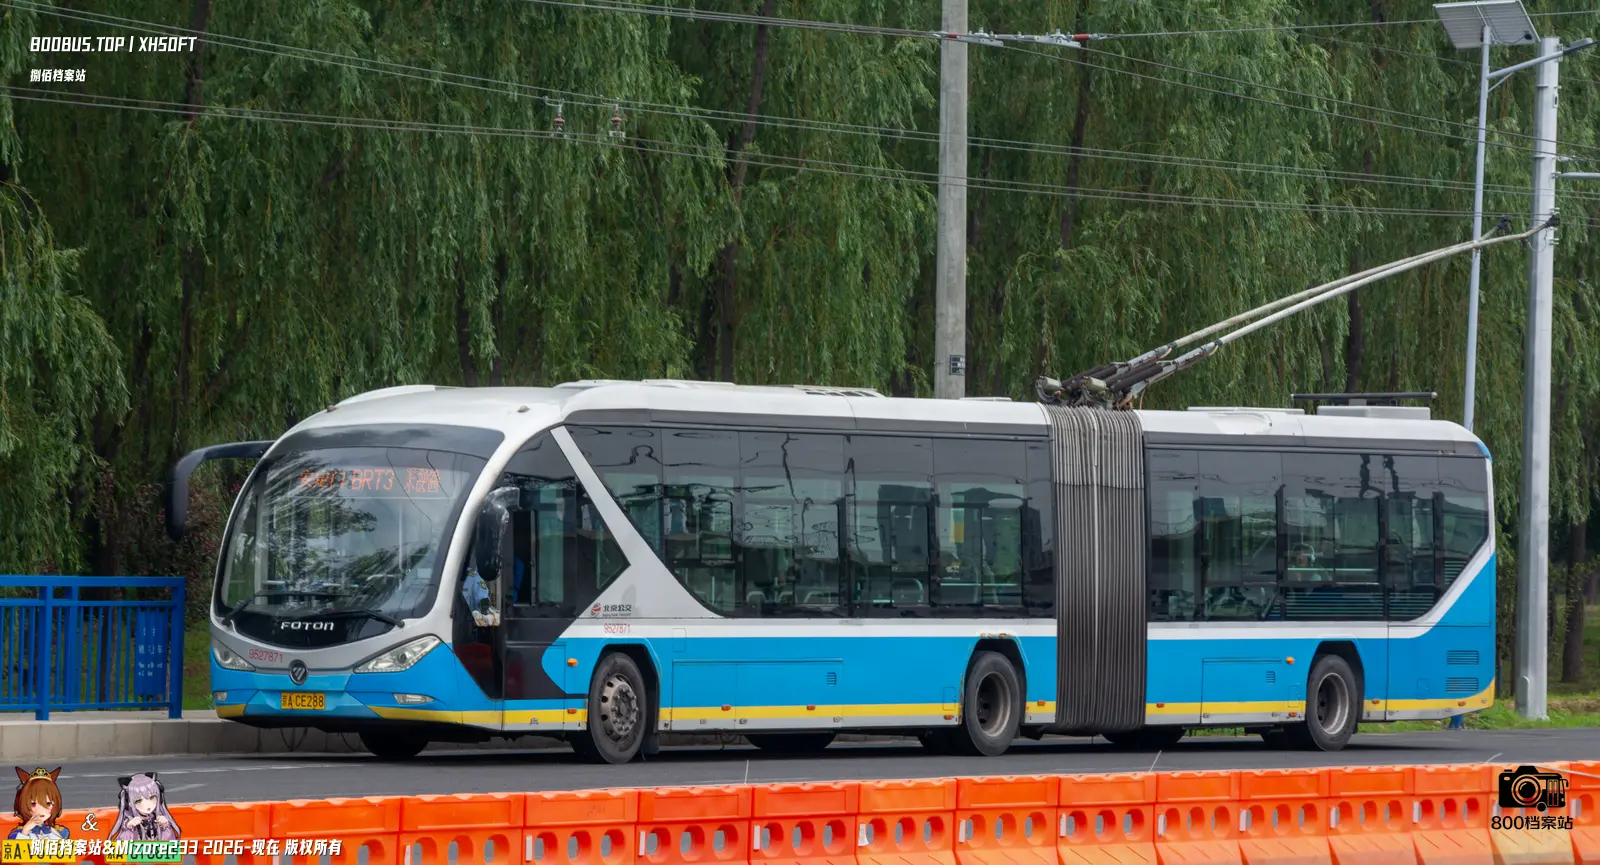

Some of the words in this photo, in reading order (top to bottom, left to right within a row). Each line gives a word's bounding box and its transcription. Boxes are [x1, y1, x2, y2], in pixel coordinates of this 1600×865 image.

[351, 469, 395, 490] BRT3
[603, 604, 632, 612] 北京公交
[280, 620, 335, 631] FOTON
[603, 623, 631, 634] 9527871
[249, 648, 284, 663] 9527871
